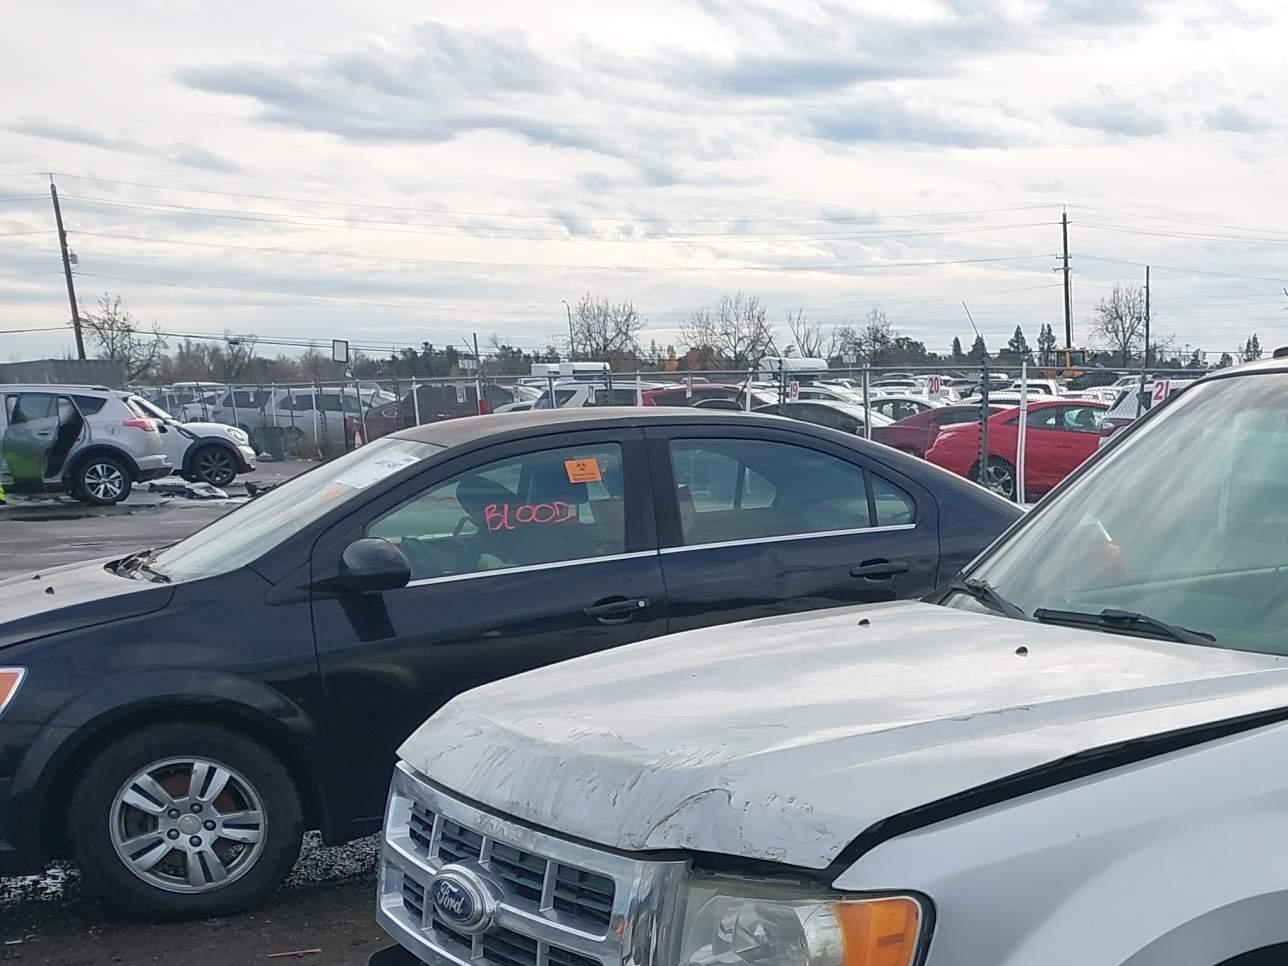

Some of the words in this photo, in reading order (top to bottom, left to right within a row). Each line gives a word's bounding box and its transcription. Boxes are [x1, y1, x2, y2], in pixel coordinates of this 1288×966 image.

[790, 382, 798, 398] 19
[928, 376, 939, 394] 20
[1153, 381, 1168, 400] 21
[484, 501, 574, 533] BLOOD
[437, 881, 464, 914] Ford
